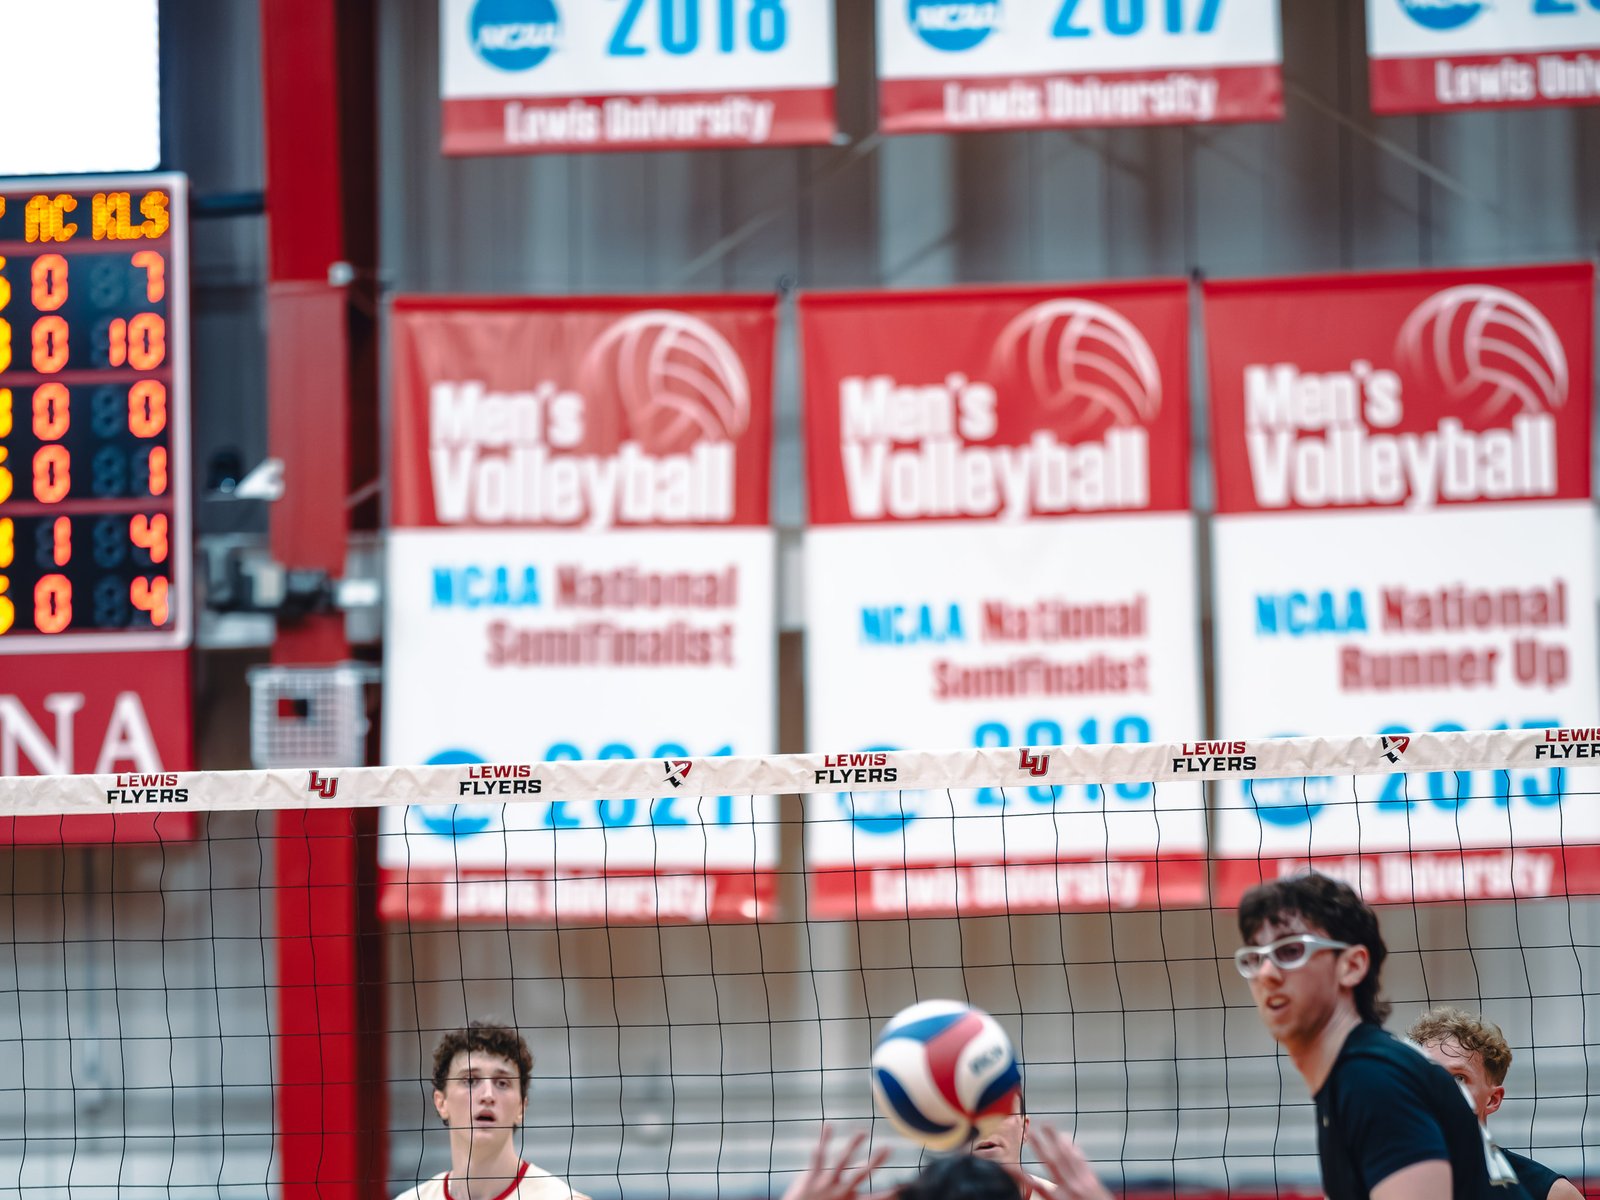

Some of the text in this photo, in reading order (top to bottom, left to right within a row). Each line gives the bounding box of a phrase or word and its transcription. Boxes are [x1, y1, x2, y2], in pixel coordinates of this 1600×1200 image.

[607, 0, 786, 57] 2018
[943, 74, 1219, 123] Lewis University
[1434, 58, 1537, 104] Lewis
[504, 97, 775, 144] Lewis University
[25, 194, 77, 242] AC
[92, 192, 169, 240] KLS
[31, 254, 69, 311] 0
[131, 250, 165, 303] 7
[31, 315, 70, 374] 0
[109, 312, 165, 371] 10
[32, 382, 70, 441] 0
[128, 379, 167, 438] 0
[431, 381, 584, 447] Men's
[839, 372, 998, 440] Men's
[1243, 360, 1403, 430] Men's
[33, 444, 71, 503] 0
[149, 446, 167, 496] 1
[429, 441, 735, 532] Volleyball
[841, 427, 1150, 522] Volleyball
[1244, 413, 1557, 510] Volleyball
[53, 516, 71, 566] 1
[130, 513, 168, 563] 4
[34, 574, 72, 633] 0
[130, 576, 168, 626] 4
[432, 562, 737, 608] NCAA National
[1256, 576, 1568, 637] NCAA National
[860, 592, 1148, 646] NCAA National
[1339, 638, 1569, 692] Runner Up
[469, 764, 531, 779] LEWIS
[824, 753, 887, 768] LEWIS
[1019, 748, 1050, 777] LU
[1172, 756, 1257, 772] FLYERS
[1182, 741, 1246, 756] LEWIS
[107, 789, 188, 804] FLYERS
[117, 774, 178, 788] LEWIS
[308, 770, 338, 799] LU
[459, 779, 542, 796] FLYERS
[814, 767, 897, 785] FLYERS
